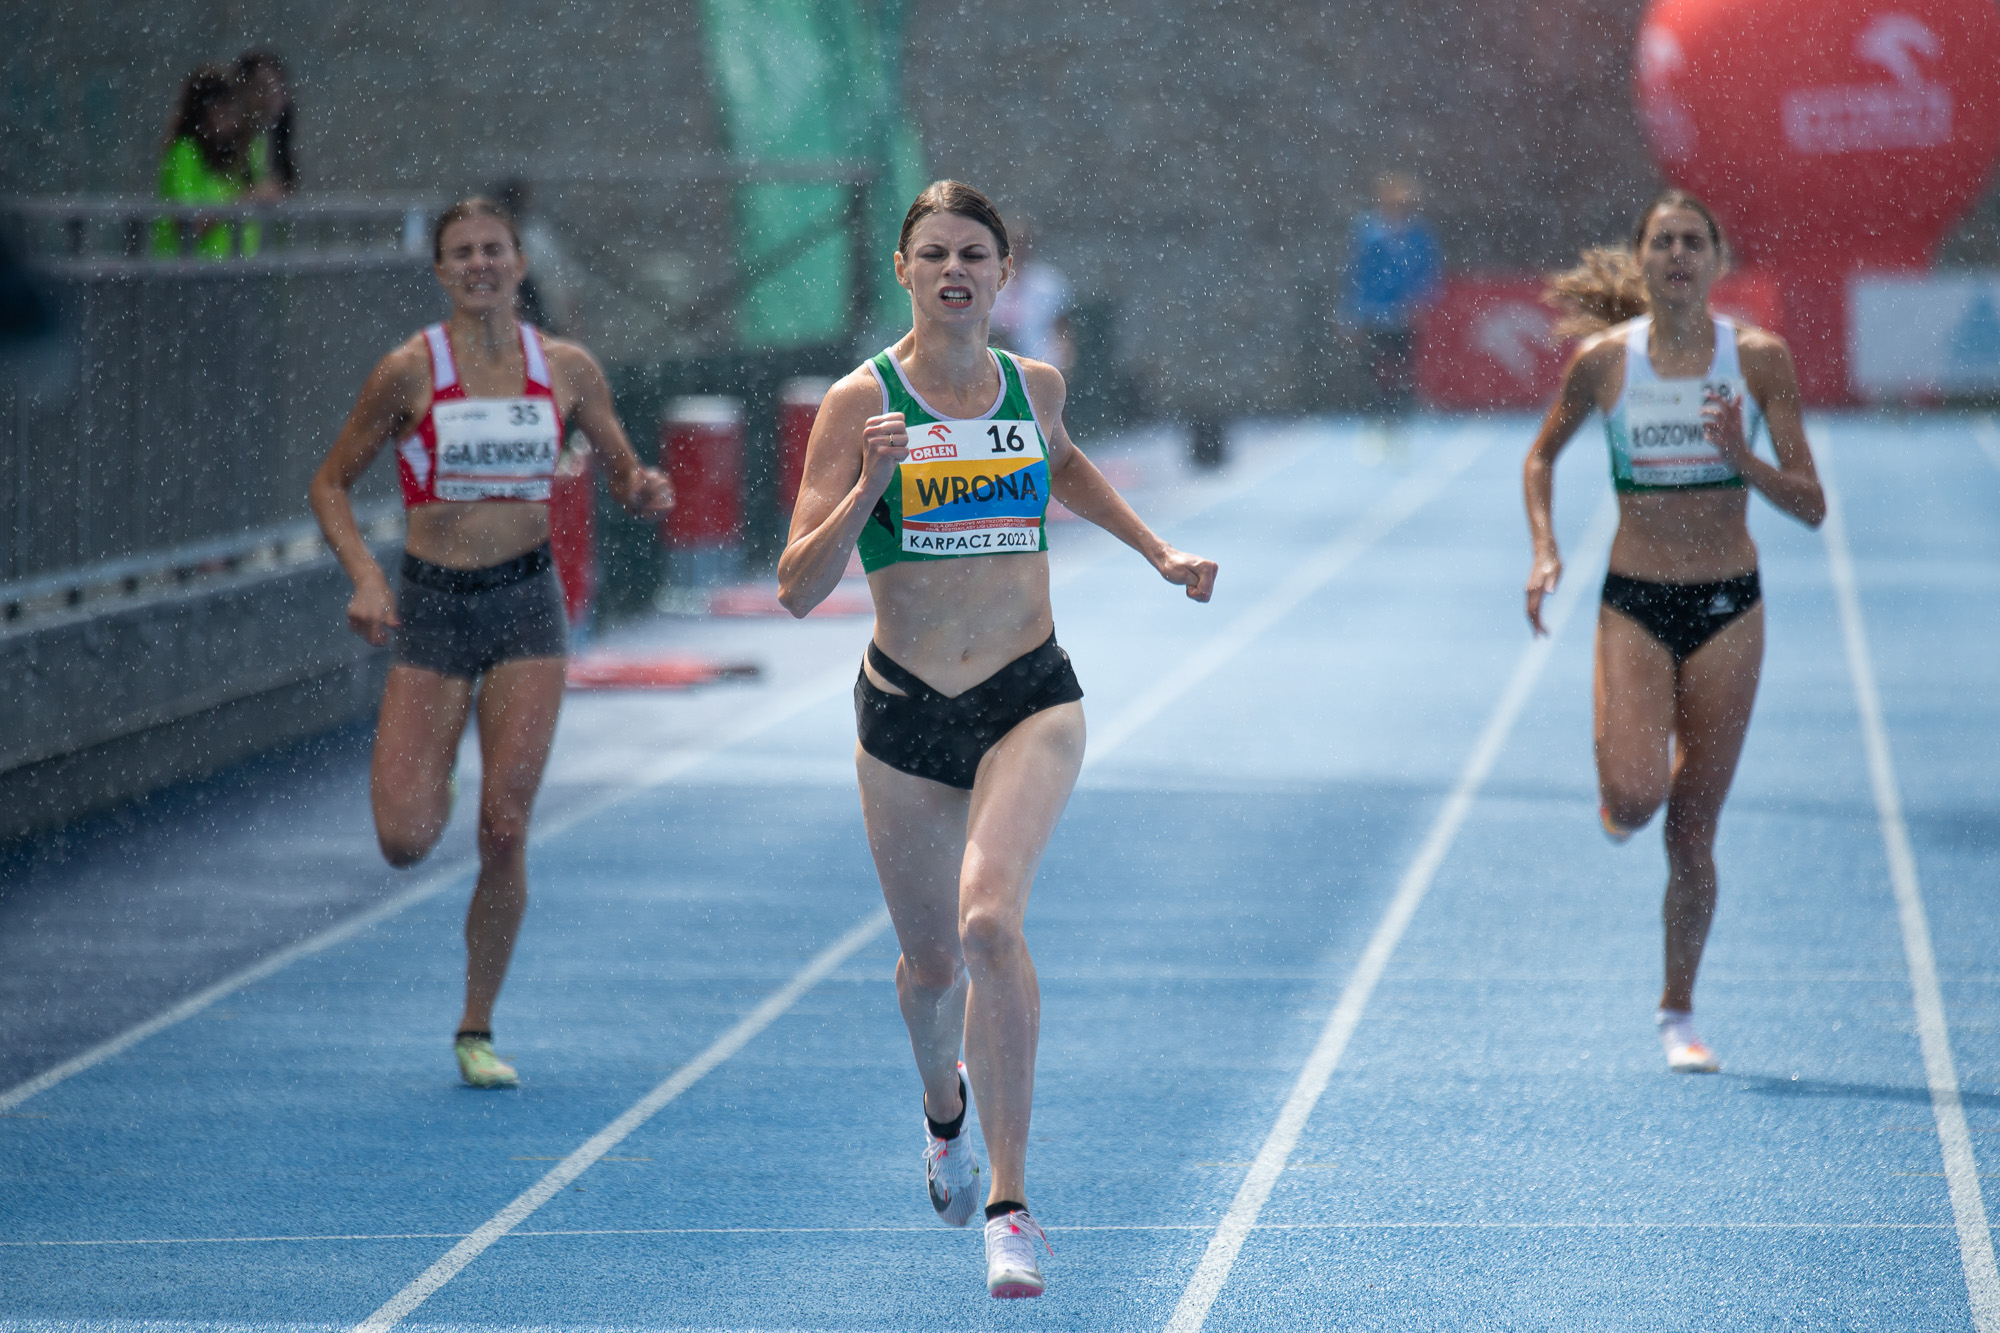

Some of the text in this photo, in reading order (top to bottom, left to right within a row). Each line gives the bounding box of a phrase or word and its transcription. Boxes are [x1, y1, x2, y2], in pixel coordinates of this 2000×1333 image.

[510, 403, 540, 426] 35
[986, 425, 1025, 453] 16
[1632, 424, 1705, 448] ŁOZOW
[442, 440, 553, 466] GAJEWSKA
[913, 446, 955, 460] ORLEN
[916, 472, 1039, 507] WRONA
[910, 532, 1028, 550] KARPACZ 2022
